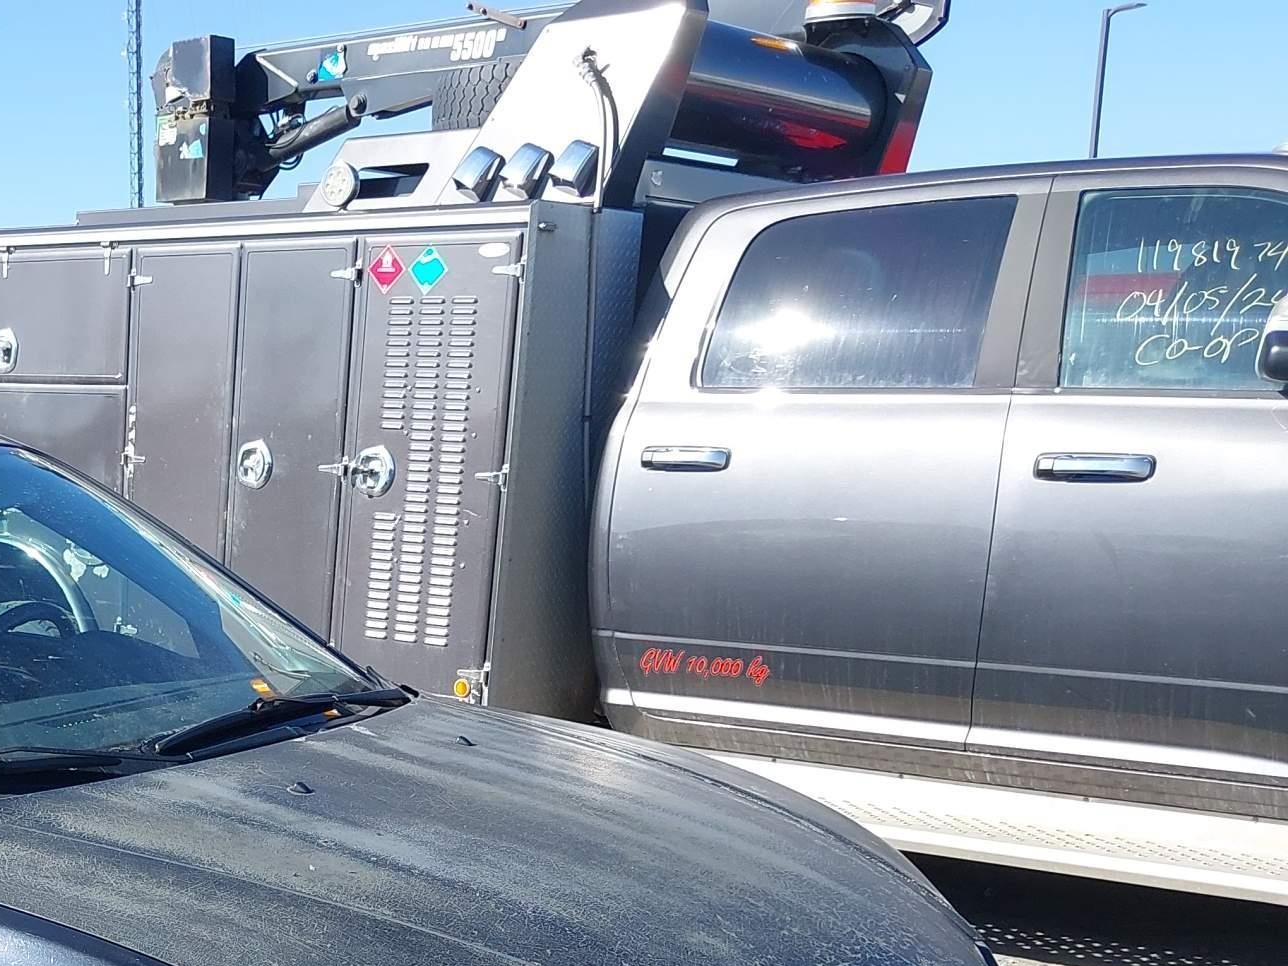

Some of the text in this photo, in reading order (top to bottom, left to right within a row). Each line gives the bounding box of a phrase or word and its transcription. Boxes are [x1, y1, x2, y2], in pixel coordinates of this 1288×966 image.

[450, 30, 497, 61] 5500
[640, 648, 770, 687] GVW 10,000 kg
